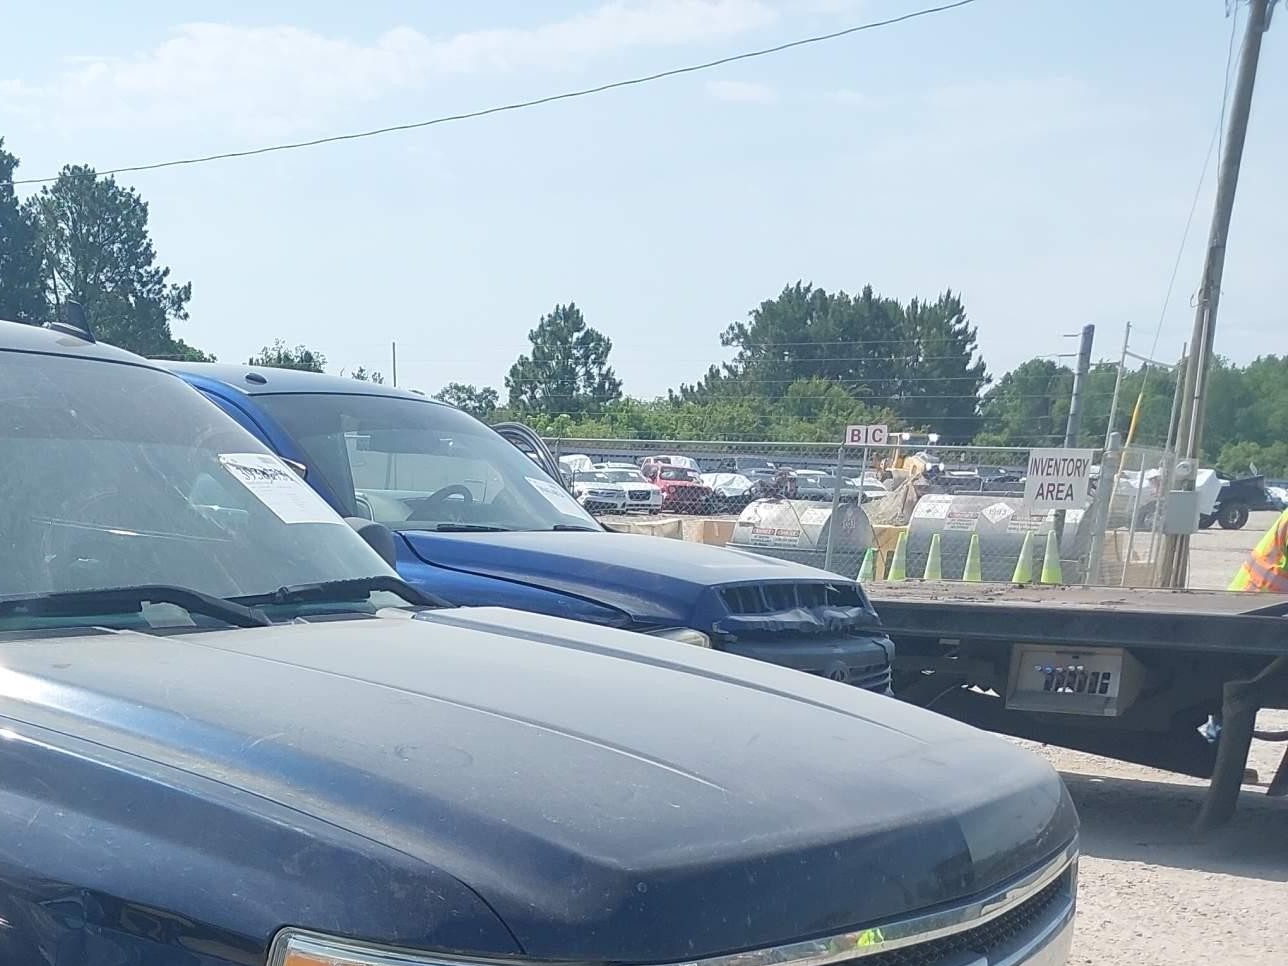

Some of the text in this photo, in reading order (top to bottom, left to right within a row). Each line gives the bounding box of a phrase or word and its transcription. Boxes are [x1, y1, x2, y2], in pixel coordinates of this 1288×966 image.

[850, 428, 862, 443] B
[871, 428, 884, 443] C
[1029, 457, 1090, 478] INVENTORY
[1034, 482, 1074, 502] AREA
